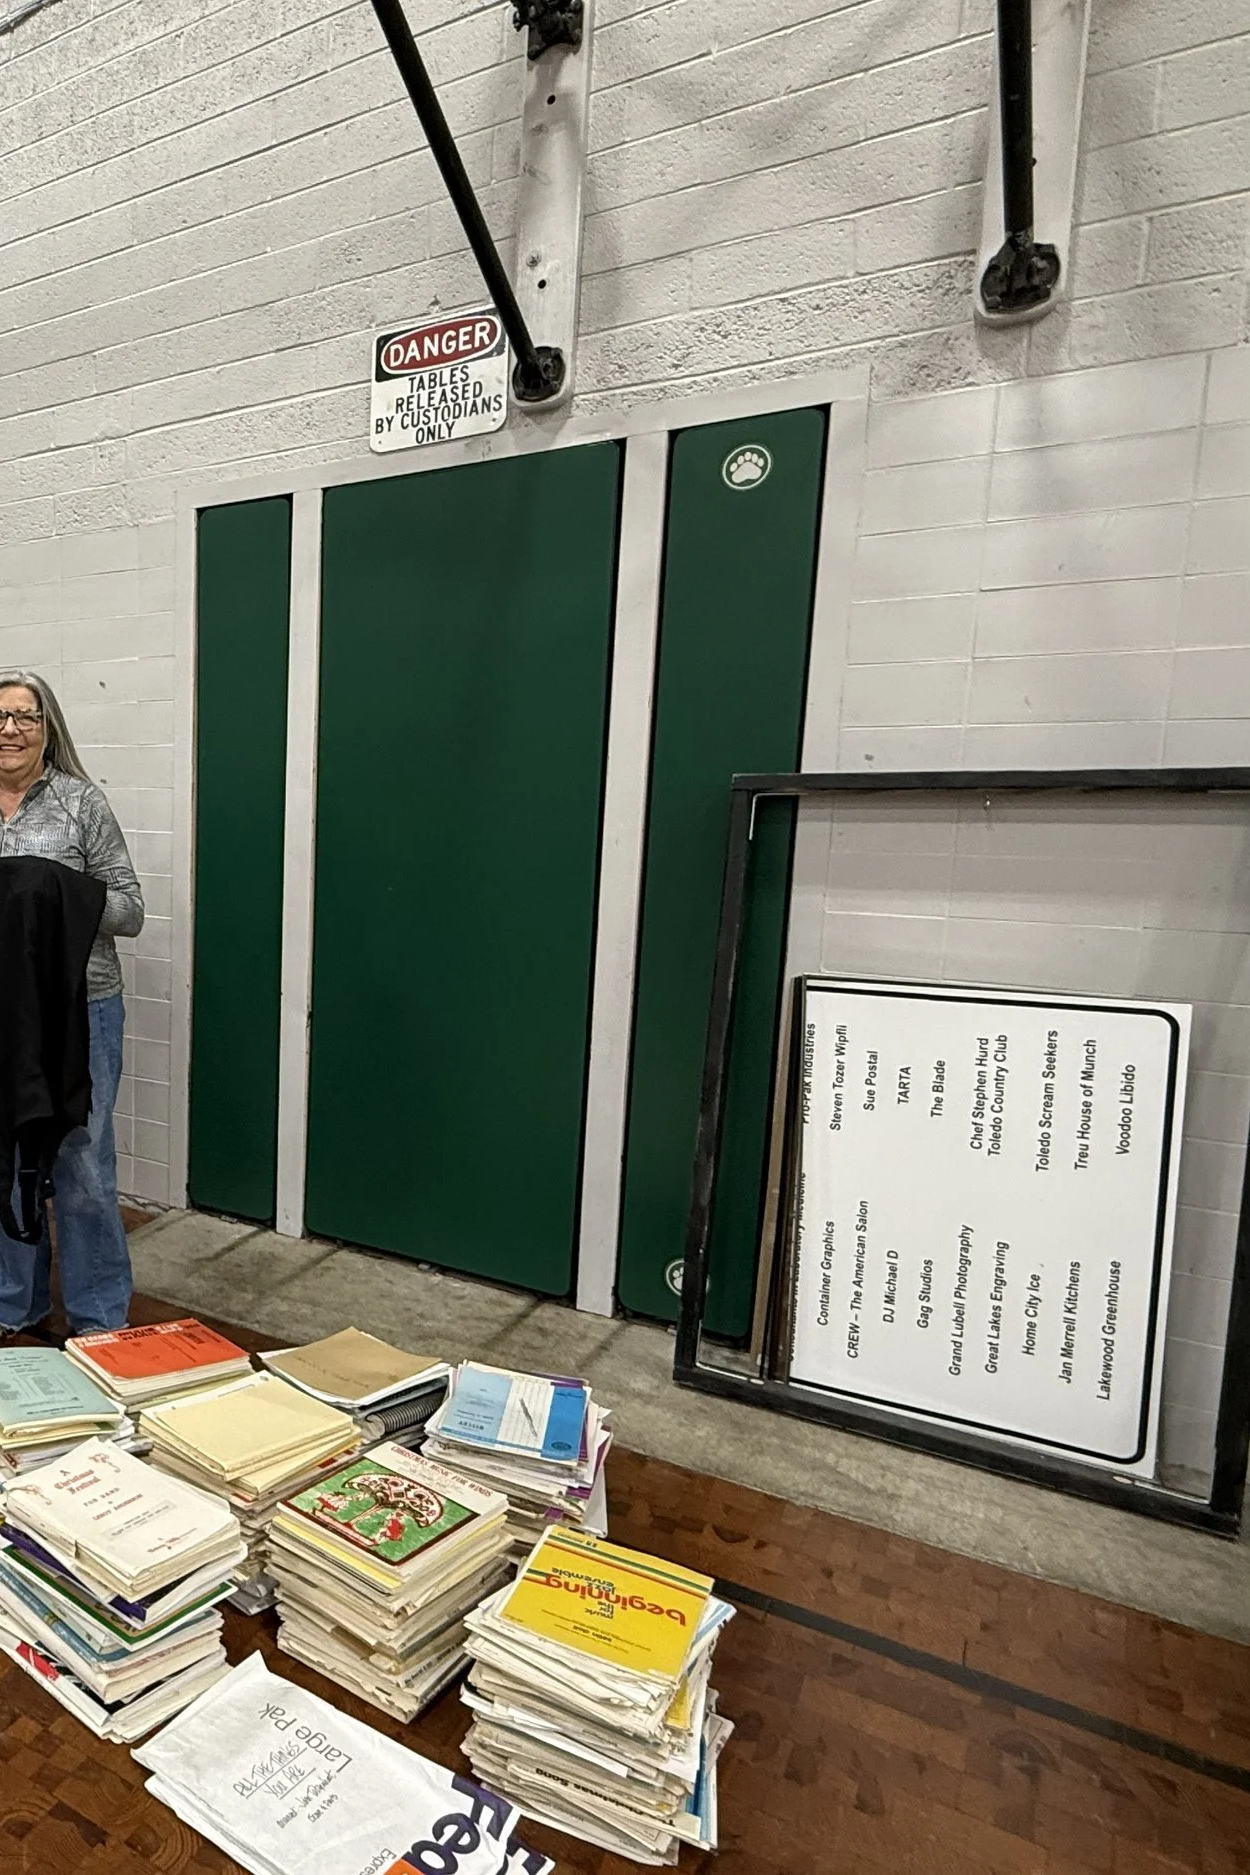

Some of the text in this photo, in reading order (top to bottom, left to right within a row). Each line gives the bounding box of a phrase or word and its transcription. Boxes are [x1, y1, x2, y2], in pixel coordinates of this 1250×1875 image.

[389, 321, 493, 368] DANGER
[395, 381, 483, 414] RELEASED
[408, 365, 469, 393] TABLES
[375, 394, 503, 435] BY CUSTODIANS
[415, 421, 455, 444] ONLY
[829, 1025, 849, 1131] Steven Tozer Wipfli
[863, 1050, 878, 1111] Sue Postal
[897, 1066, 912, 1104] TARTA
[931, 1060, 946, 1118] The Blade
[970, 1037, 989, 1150] Chef Stephen Hurd
[988, 1034, 1009, 1157] Toledo Country Club
[1035, 1030, 1058, 1172] Toledo Scream Seekers
[1074, 1039, 1097, 1170] Treu House of Munch
[1115, 1064, 1136, 1155] Voodoo Libido
[855, 1200, 869, 1233] Salon
[817, 1220, 836, 1326] Container Graphics
[852, 1235, 866, 1289] American
[883, 1250, 899, 1324] DJ Michael D
[850, 1290, 863, 1311] The
[917, 1259, 933, 1329] Gag Studios
[949, 1225, 974, 1376] Grand Lubell Photography
[985, 1241, 1010, 1374] Great Lakes Engraving
[1022, 1274, 1042, 1356] Home City Ice
[1058, 1261, 1081, 1384] Jan Merrell Kitchens
[847, 1322, 860, 1359] CREW
[1096, 1260, 1121, 1400] Lakewood Greenhouse
[54, 1469, 95, 1490] Christmas
[545, 1574, 686, 1626] beginning
[551, 1567, 615, 1587] ensemble
[587, 1581, 616, 1595] jazz
[584, 1607, 614, 1620] music
[258, 1703, 353, 1773] Large Pak
[535, 1768, 569, 1786] Song
